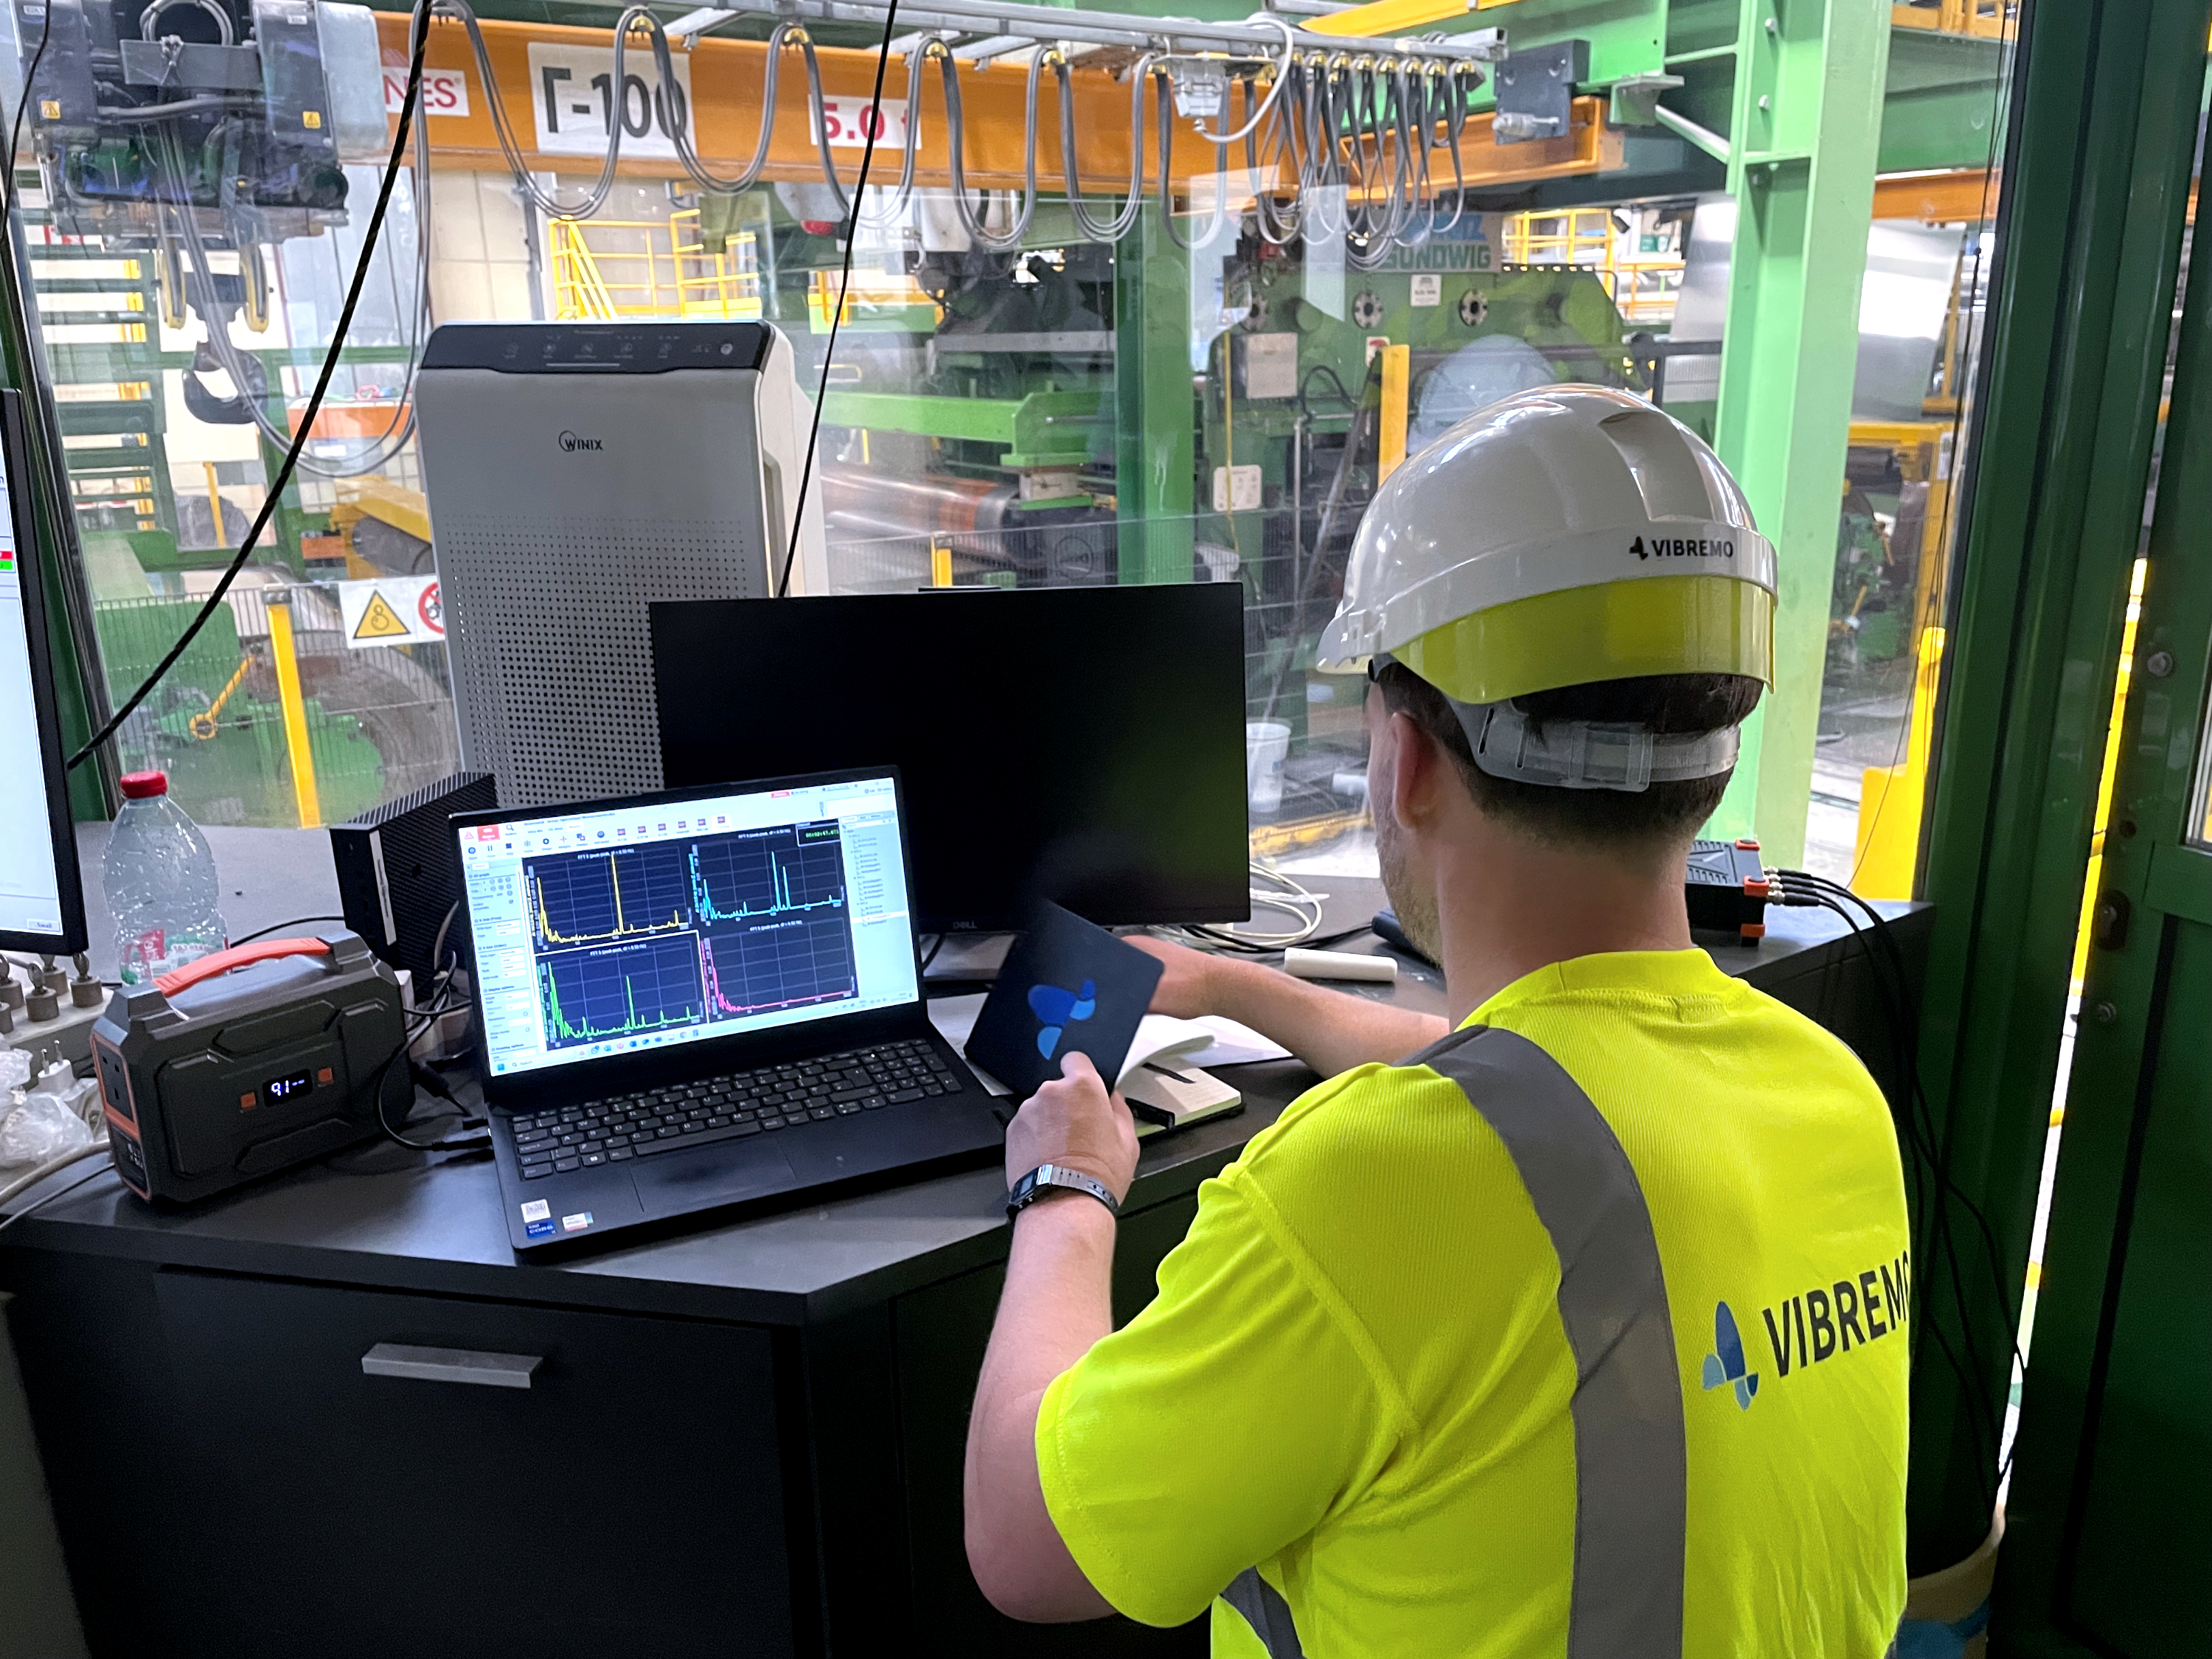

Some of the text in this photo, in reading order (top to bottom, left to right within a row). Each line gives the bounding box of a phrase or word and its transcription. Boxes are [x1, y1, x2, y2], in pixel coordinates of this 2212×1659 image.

[823, 102, 886, 141] 5.0
[563, 437, 603, 451] WINIX
[1651, 539, 1733, 557] VIBREMO
[953, 921, 978, 929] DELL
